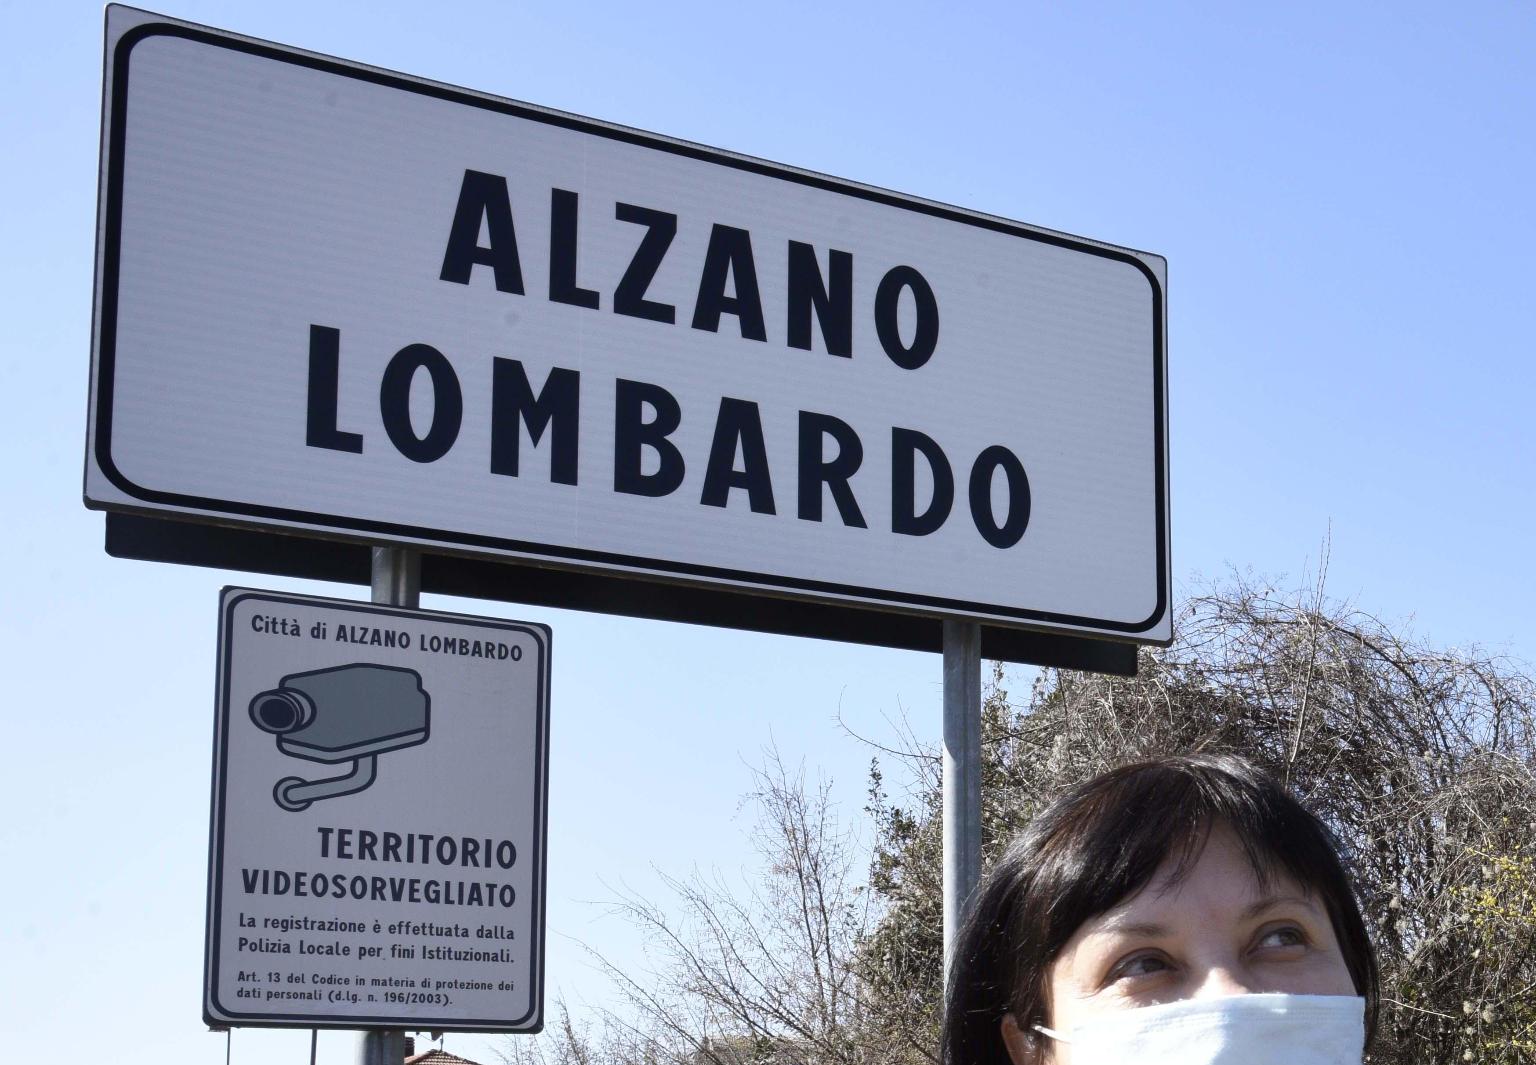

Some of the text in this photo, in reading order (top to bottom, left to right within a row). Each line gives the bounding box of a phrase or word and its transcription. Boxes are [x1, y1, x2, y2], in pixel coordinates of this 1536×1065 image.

[439, 168, 940, 371] ALZANO
[305, 323, 1032, 550] LOMBARDO
[251, 614, 523, 662] Città di ALZANO LOMBARDO
[317, 827, 517, 870] TERRITORIO
[241, 868, 516, 908] VIDEOSORVEGLIATO
[239, 912, 515, 941] La registrazione è effettuata dalla
[238, 936, 515, 964] Polizia Locale per fini Istituzionali.
[236, 987, 453, 1007] dati personali (d.lg. n. 196/2003).
[237, 971, 515, 991] Art. 13 del Codice in materia di protezione dei
